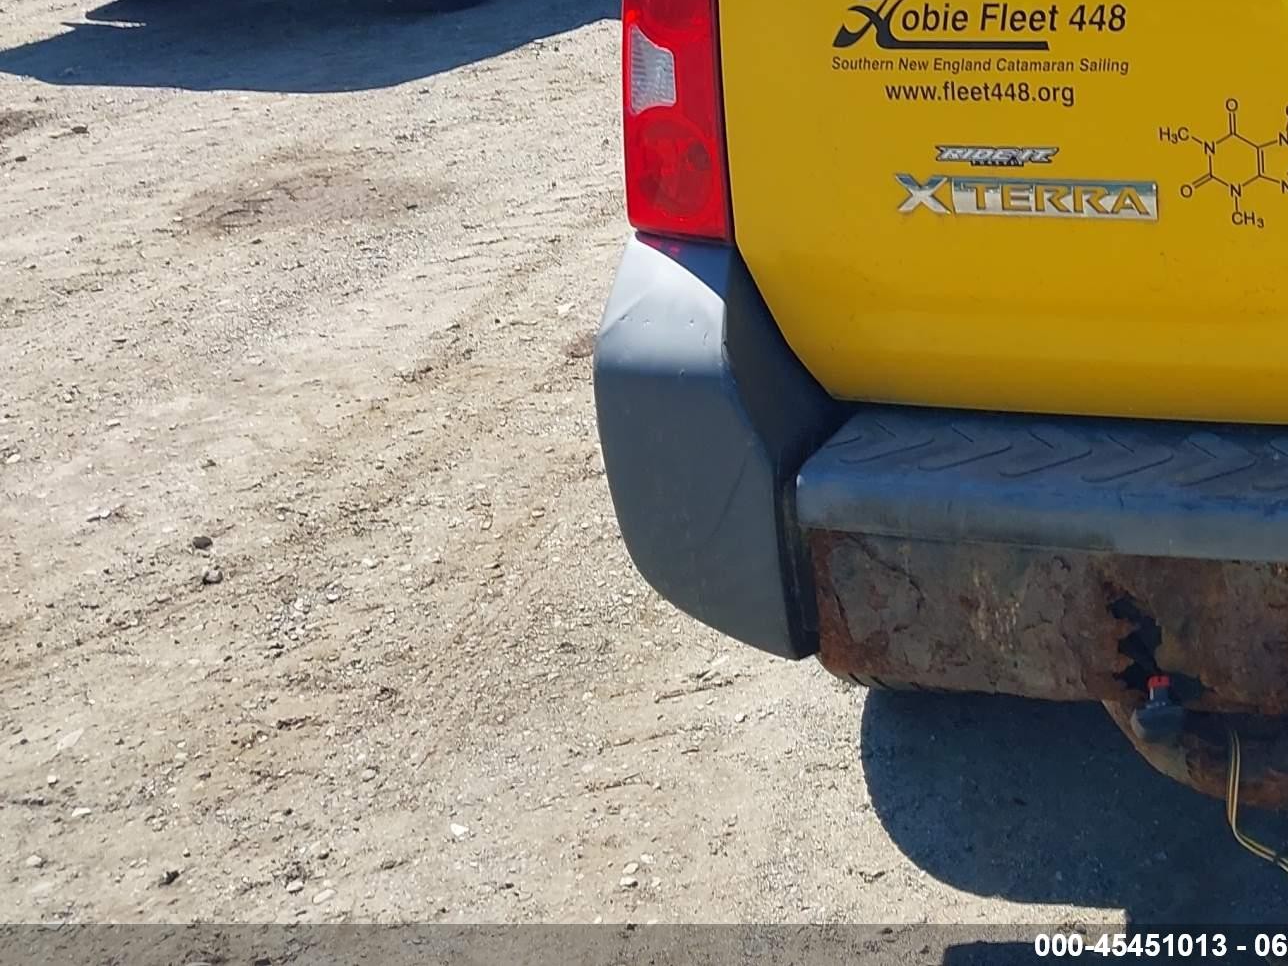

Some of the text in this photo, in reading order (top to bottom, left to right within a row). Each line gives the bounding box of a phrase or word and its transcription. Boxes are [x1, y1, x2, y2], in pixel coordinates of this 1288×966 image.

[980, 2, 1059, 32] Fleet
[1068, 4, 1127, 32] 448
[831, 56, 1130, 76] Southern New England Catamaran Sailing
[884, 80, 1076, 108] www.fleet448.org
[895, 174, 1158, 221] XTERRA
